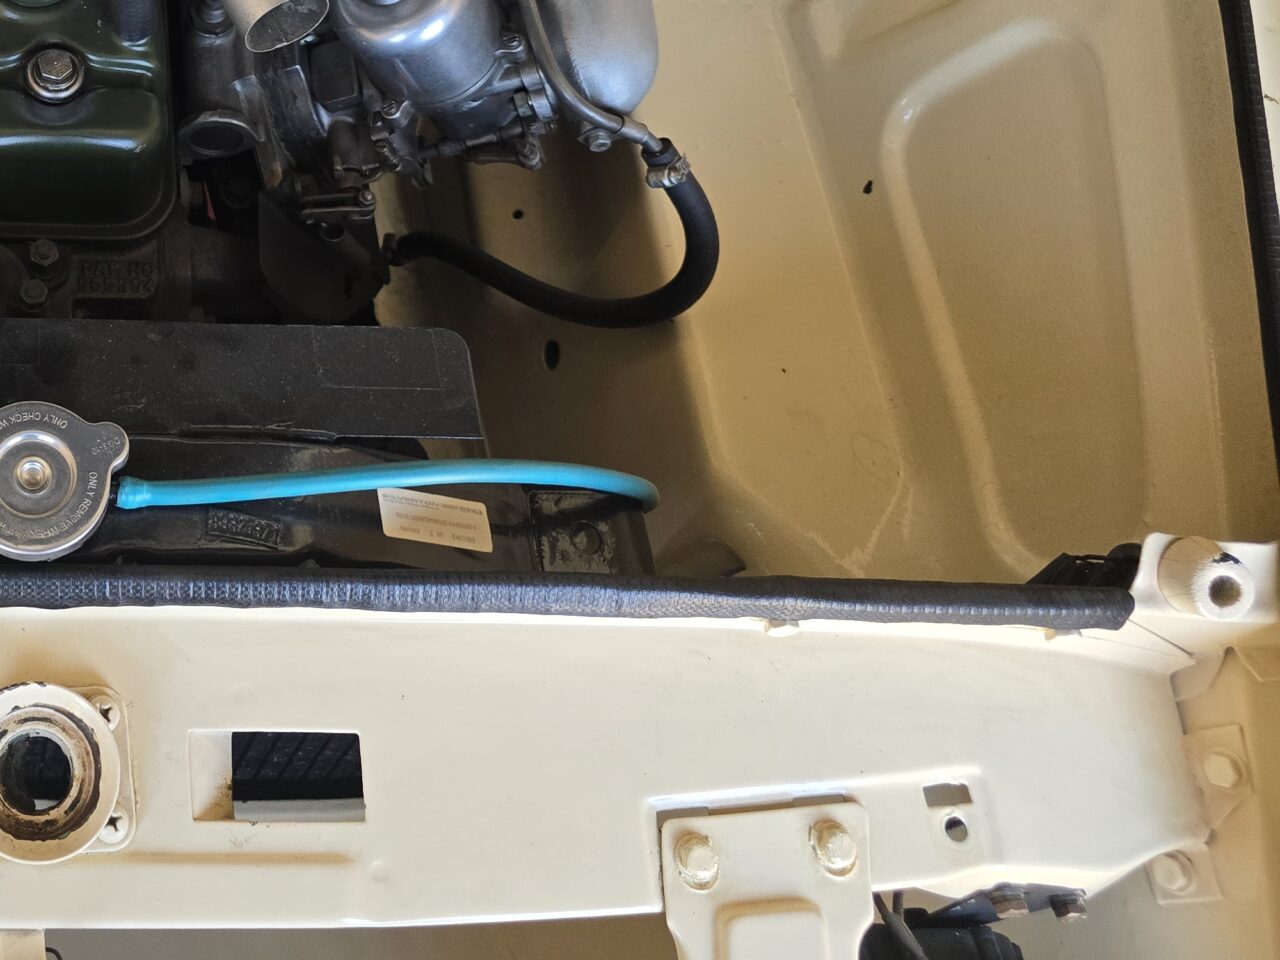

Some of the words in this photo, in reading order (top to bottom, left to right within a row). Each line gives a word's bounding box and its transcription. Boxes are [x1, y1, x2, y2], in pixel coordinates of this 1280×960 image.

[10, 411, 41, 421] CHECK
[44, 413, 68, 429] ONLY
[88, 471, 99, 498] ONLY
[60, 498, 92, 532] REMOVE
